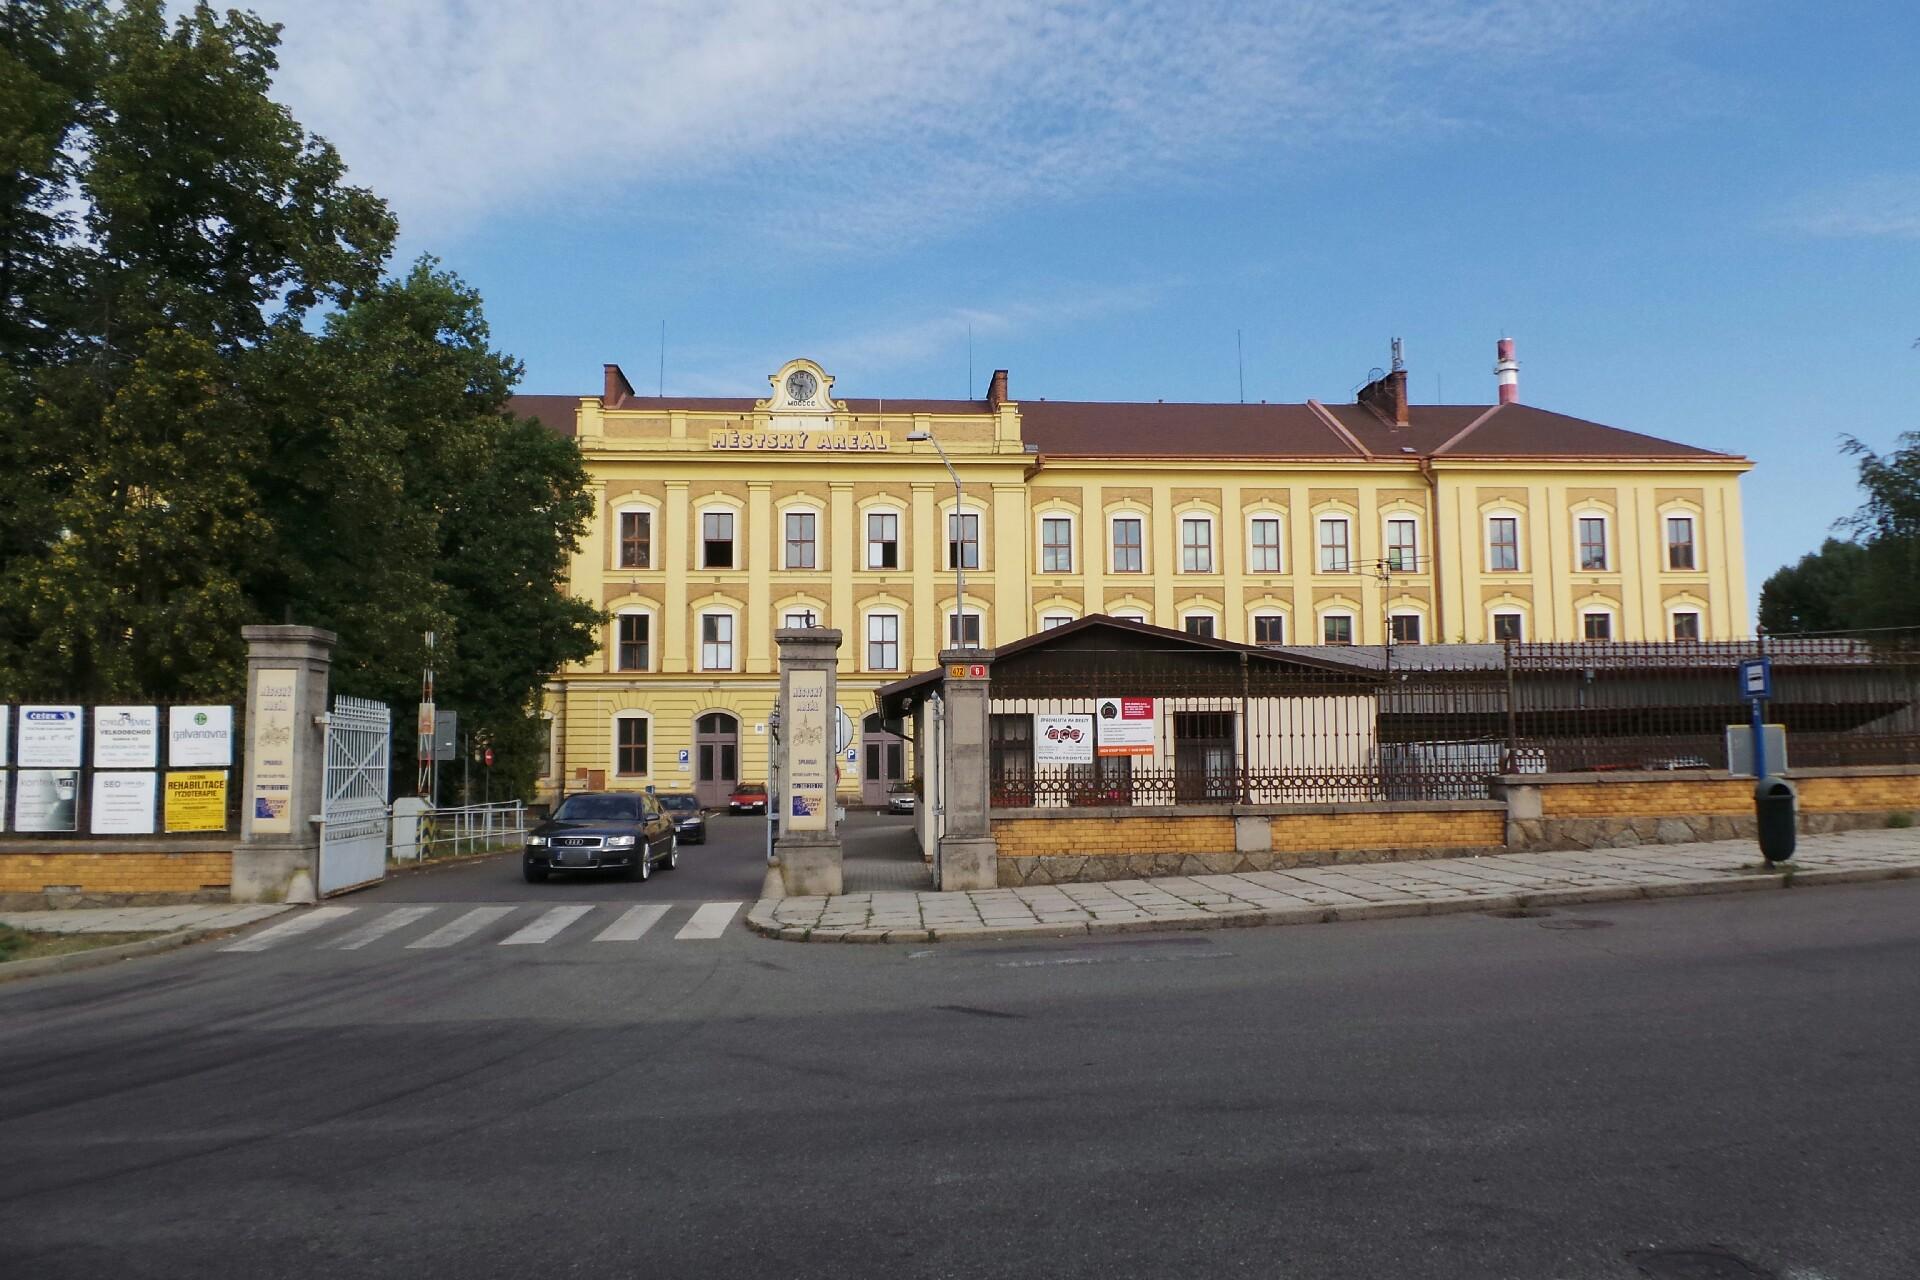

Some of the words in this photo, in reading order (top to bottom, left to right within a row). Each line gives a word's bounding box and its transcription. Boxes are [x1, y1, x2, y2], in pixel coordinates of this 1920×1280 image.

[711, 430, 808, 449] MĚSTSKÝ
[817, 431, 887, 450] AREÁL
[173, 727, 228, 742] galvanovna
[680, 751, 687, 760] P
[847, 749, 855, 759] P
[103, 780, 121, 788] SEO
[168, 780, 225, 790] REHABILITACE
[174, 790, 217, 798] FYZIOTERAPIE
